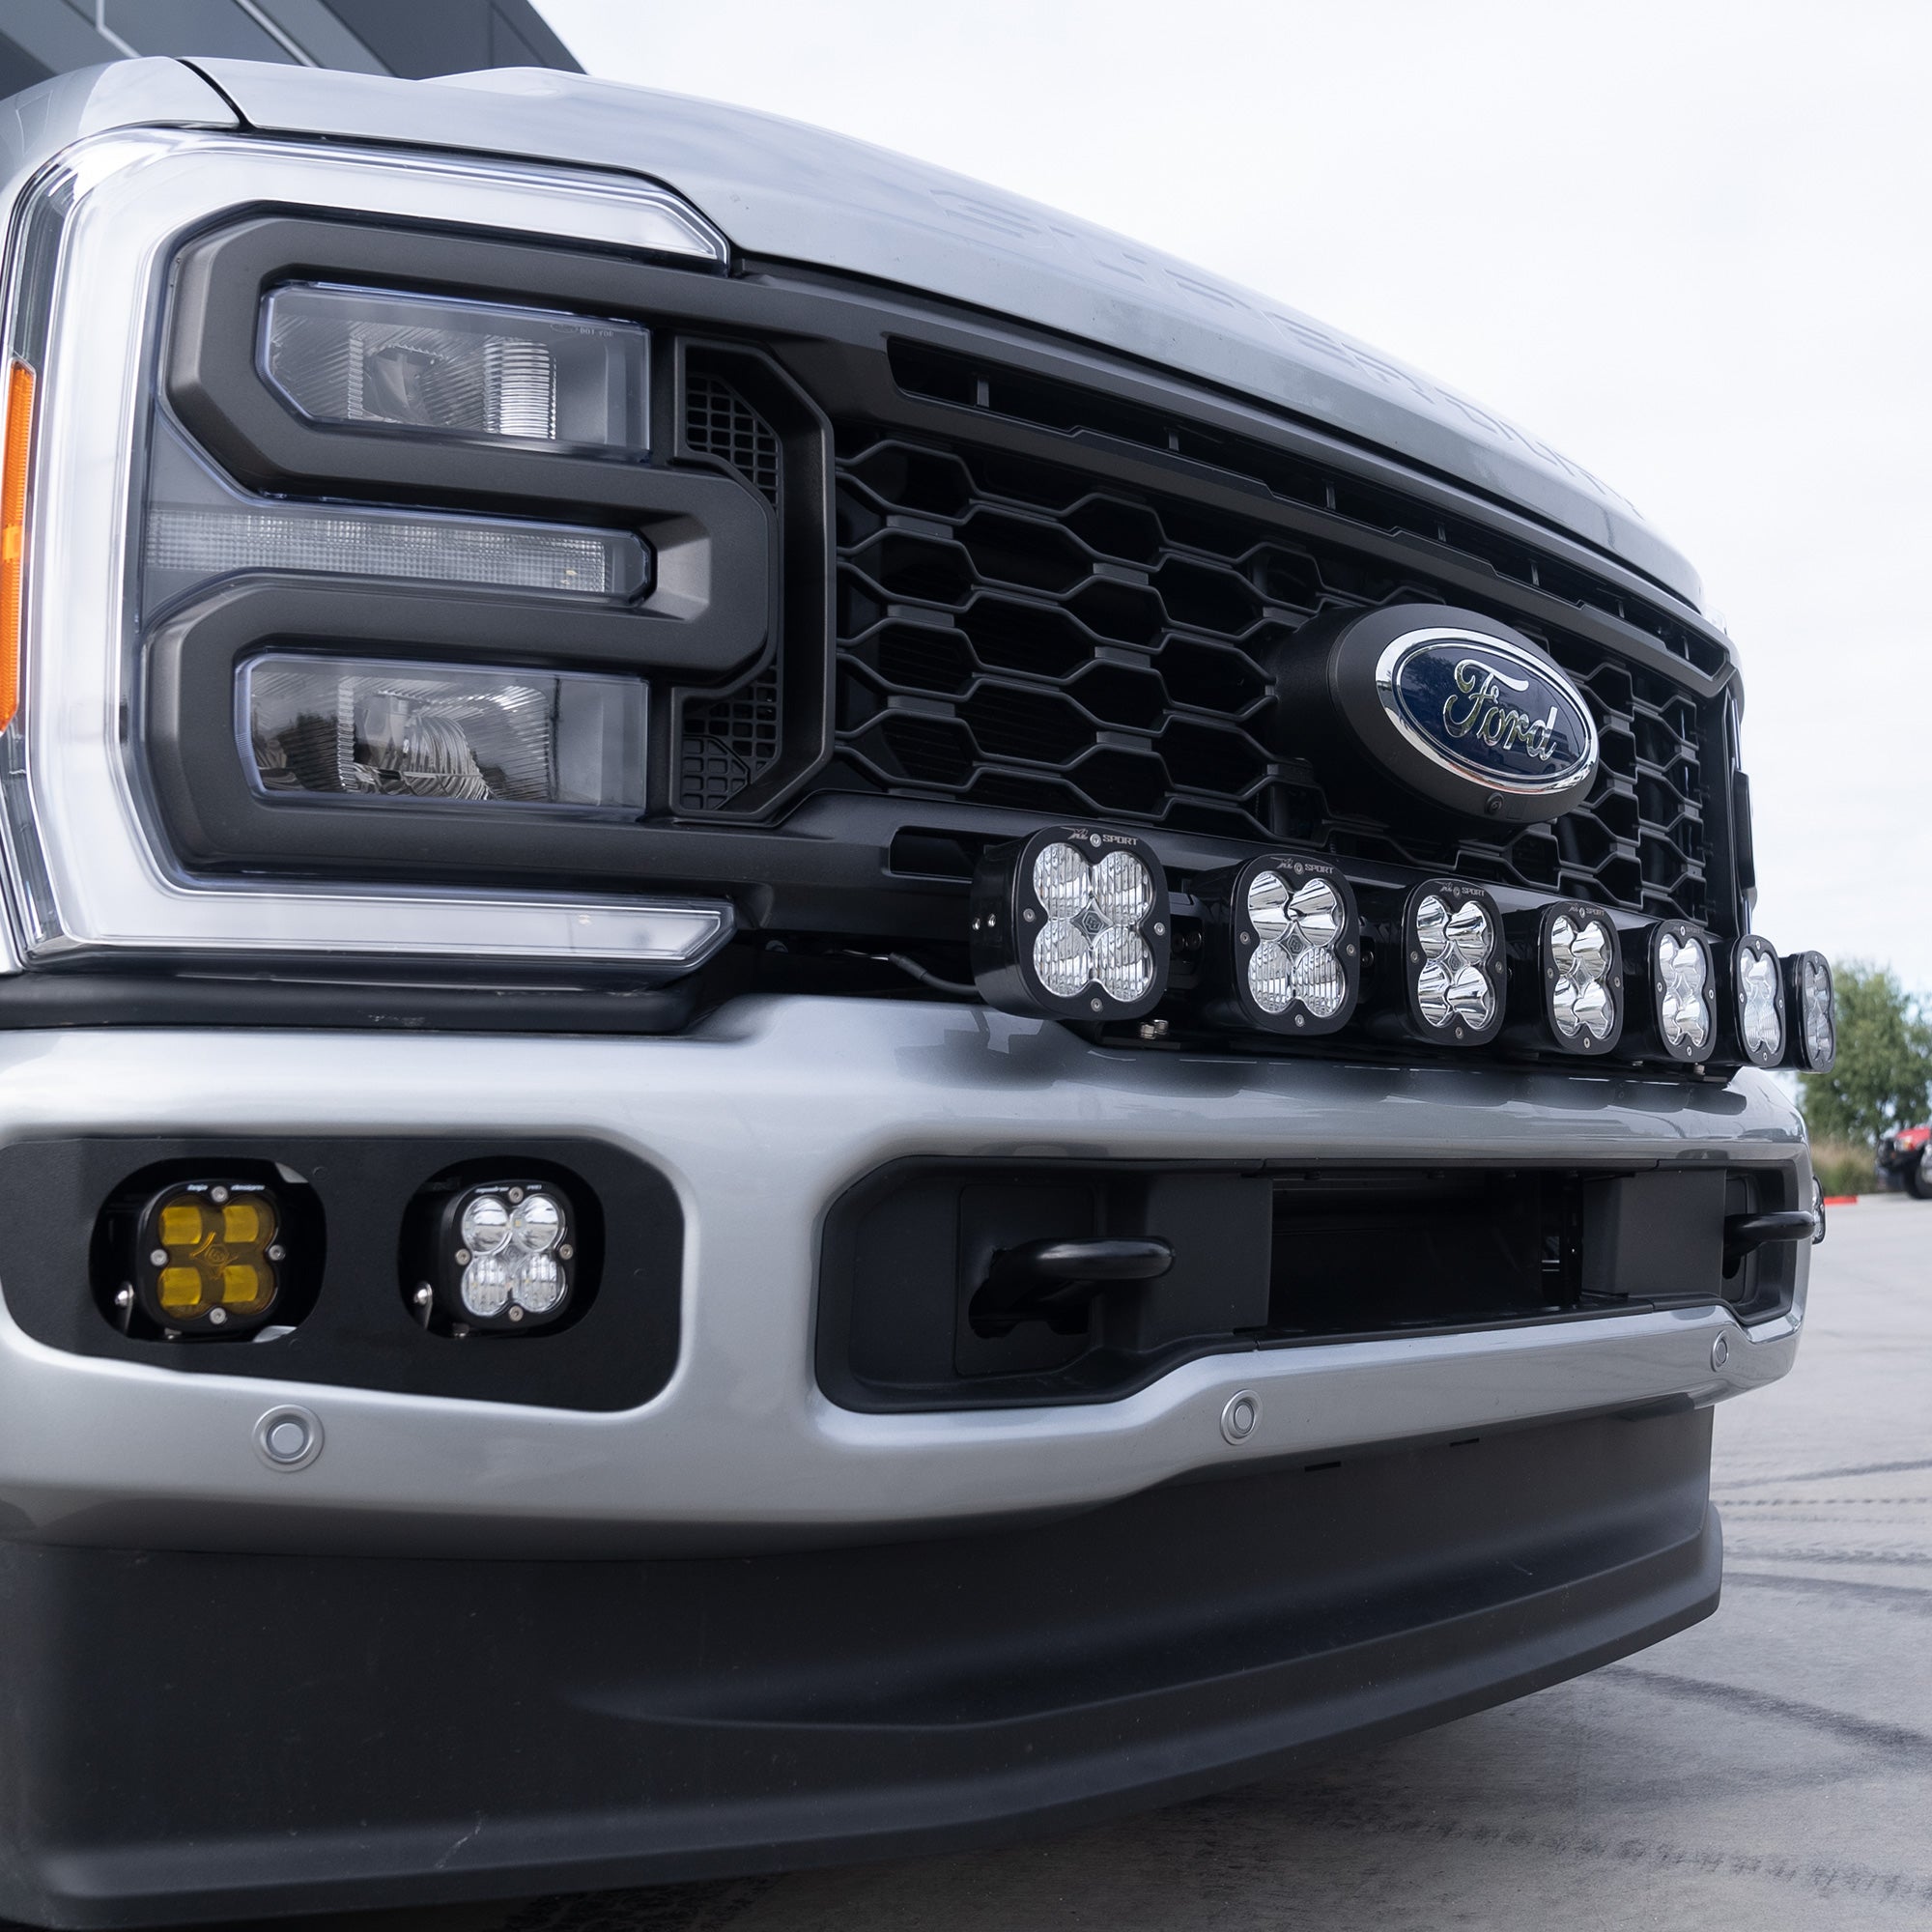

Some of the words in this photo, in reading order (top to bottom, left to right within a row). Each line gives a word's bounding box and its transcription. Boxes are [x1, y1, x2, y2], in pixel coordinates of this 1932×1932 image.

[1443, 659, 1558, 761] Ford
[1102, 834, 1138, 845] SPORT
[1304, 863, 1334, 874] SPORT
[1461, 887, 1485, 896] SPORT
